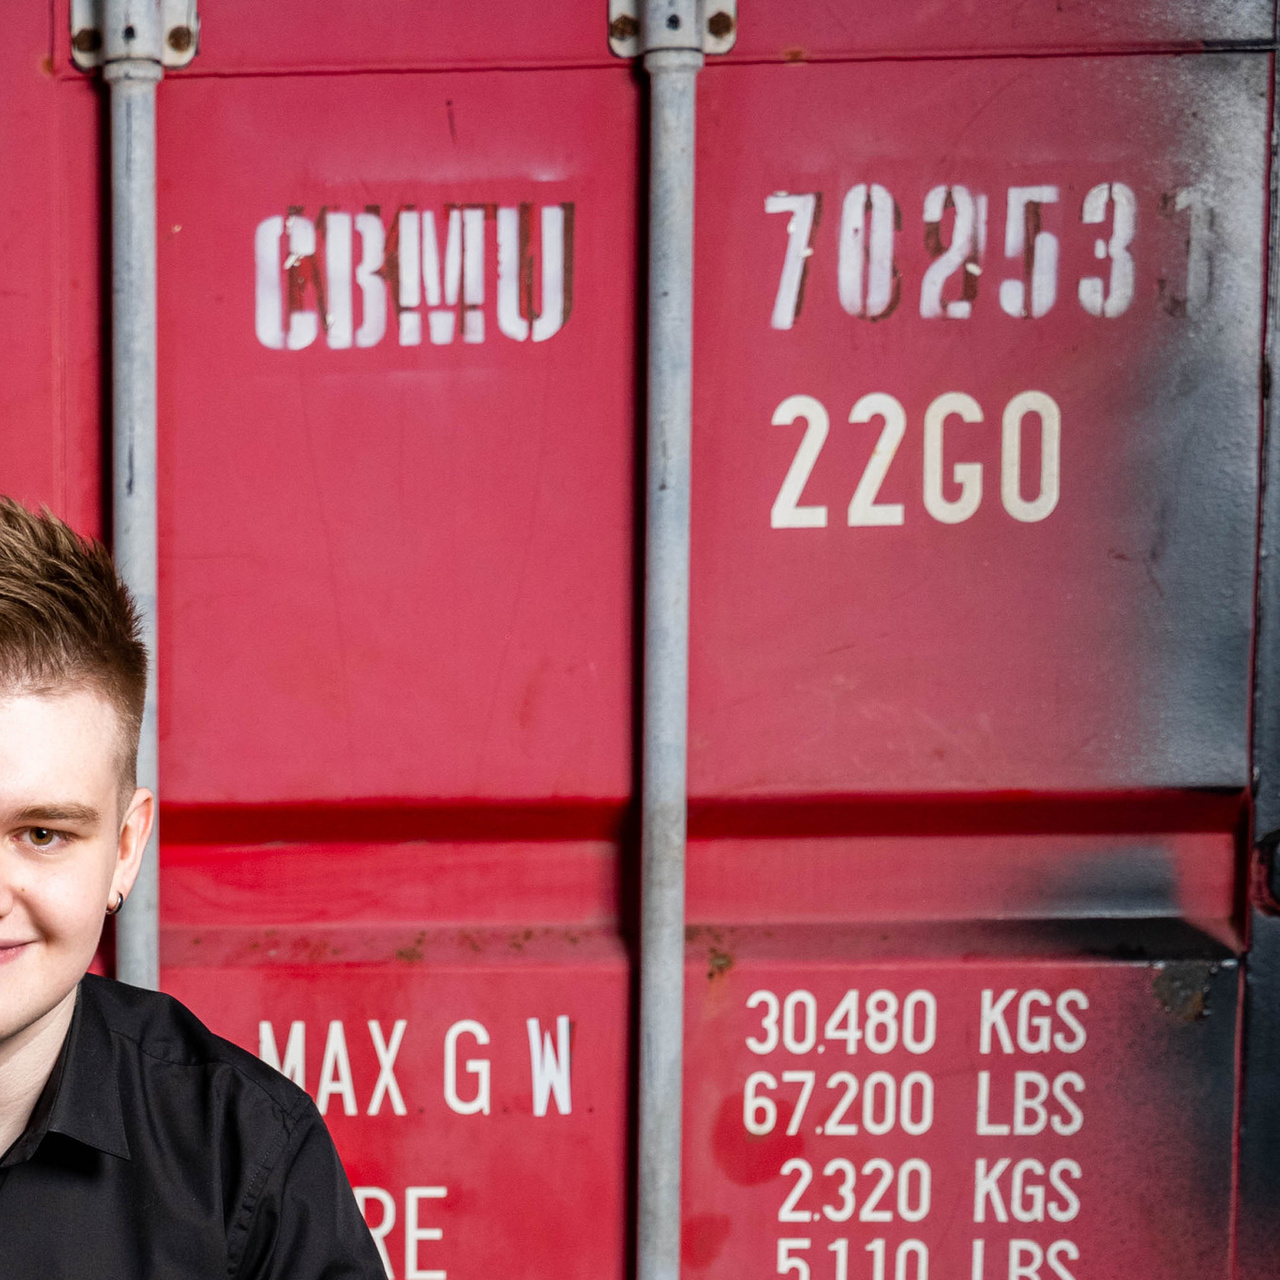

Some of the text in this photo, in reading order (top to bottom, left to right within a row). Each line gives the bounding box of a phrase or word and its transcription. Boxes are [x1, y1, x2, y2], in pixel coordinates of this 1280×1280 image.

[255, 207, 564, 351] CBMU
[745, 989, 1088, 1055] 30.480 KGS
[259, 1015, 572, 1117] MAX G W
[743, 1070, 1085, 1136] 67.200 LBS
[778, 1158, 1081, 1223] 2.320 KGS
